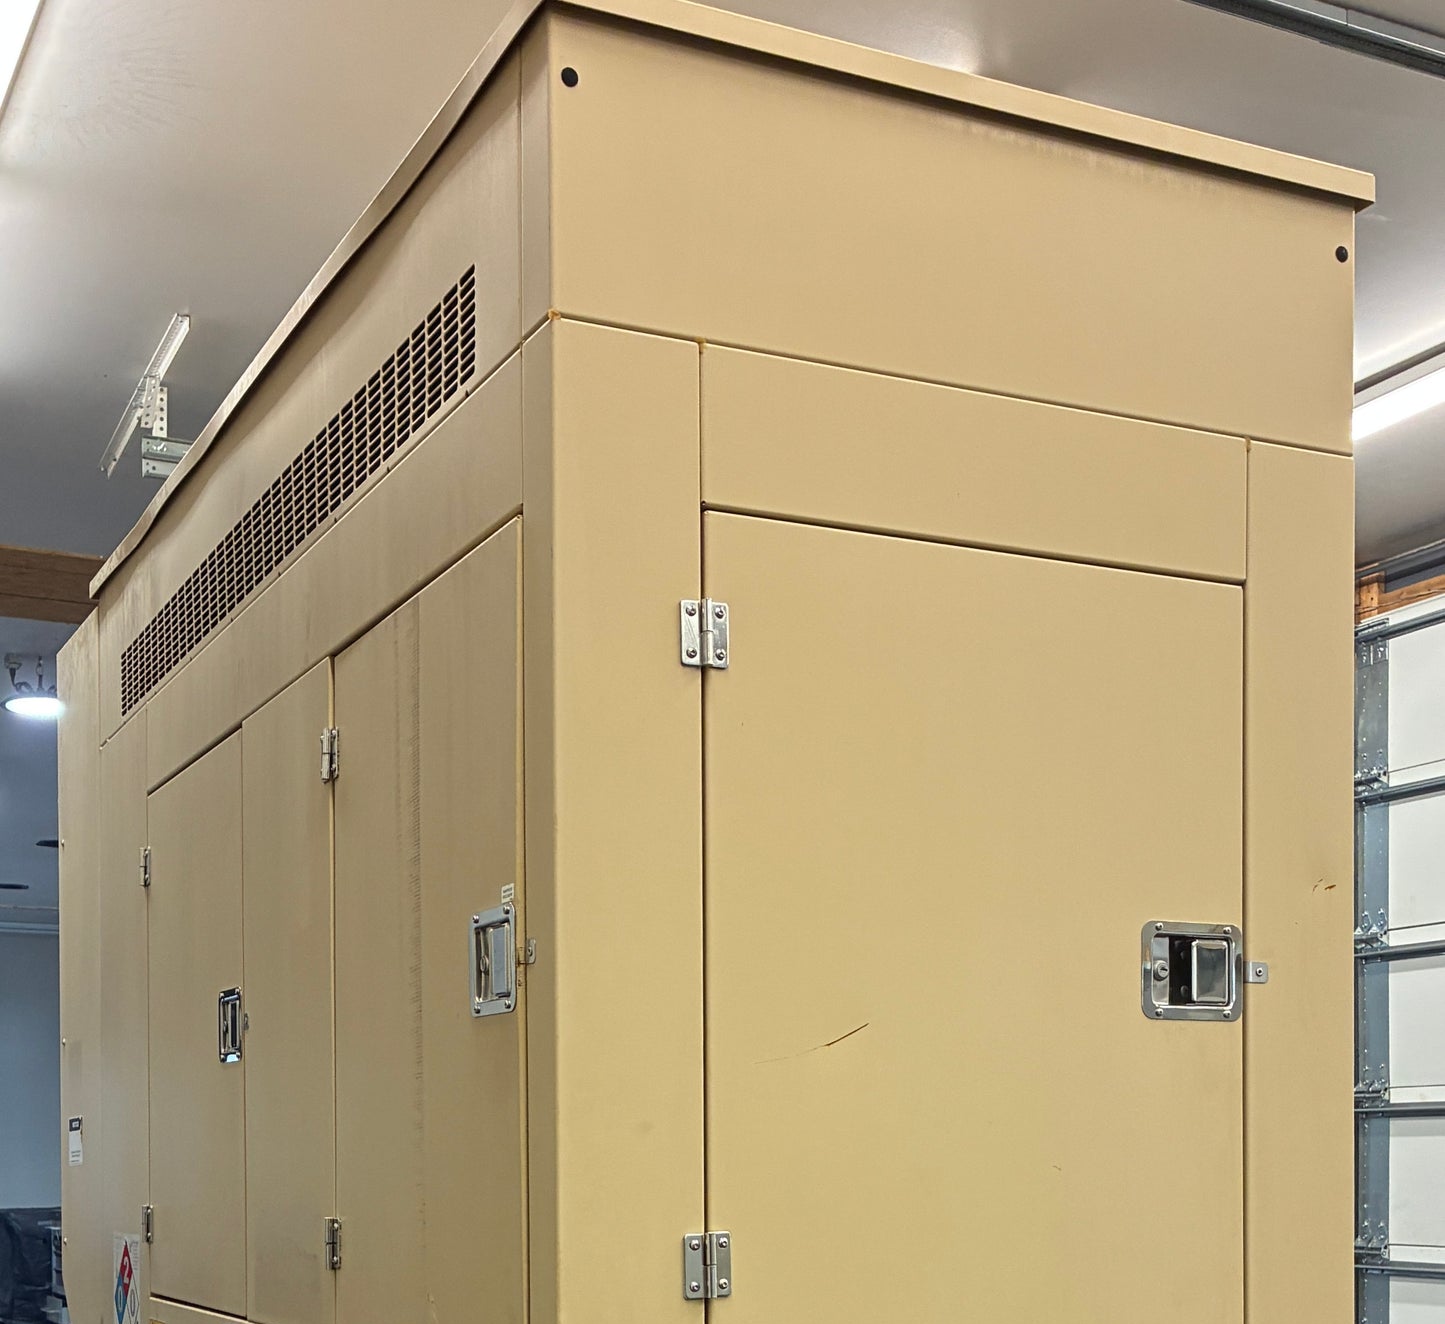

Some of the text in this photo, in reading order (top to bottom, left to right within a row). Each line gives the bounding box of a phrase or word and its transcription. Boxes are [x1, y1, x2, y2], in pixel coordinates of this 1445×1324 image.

[123, 1255, 130, 1285] 2
[117, 1285, 136, 1318] 0 0
